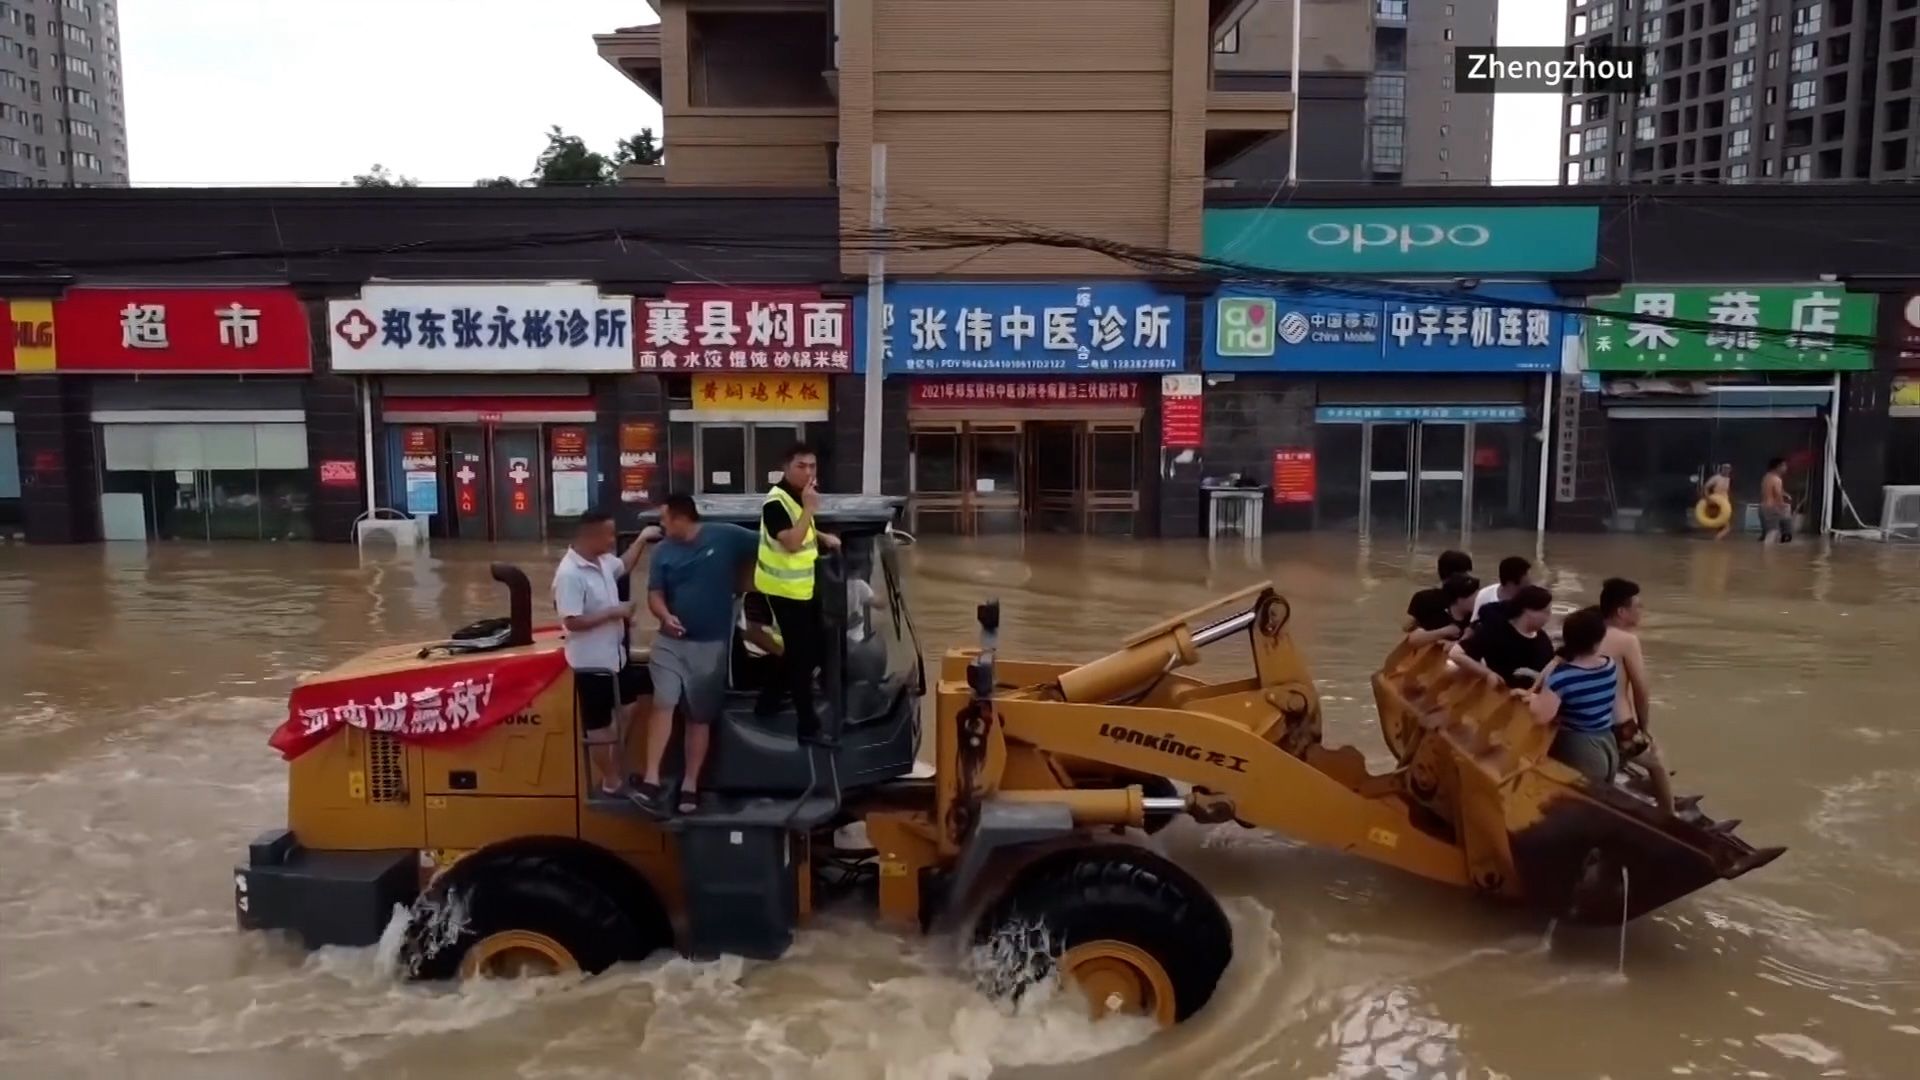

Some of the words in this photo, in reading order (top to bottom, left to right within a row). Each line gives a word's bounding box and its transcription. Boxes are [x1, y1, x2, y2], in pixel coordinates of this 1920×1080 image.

[120, 302, 262, 349] 超市
[381, 305, 627, 349] 郑东张永彬诊所
[645, 300, 847, 348] 襄县焖面
[909, 305, 1171, 351] 张伟中医诊所
[1311, 312, 1378, 329] 中国移动
[1311, 332, 1340, 342] China
[1344, 332, 1376, 342] Mobile
[1391, 305, 1550, 348] 中宇手机连锁
[1625, 291, 1841, 350] 果蔬店
